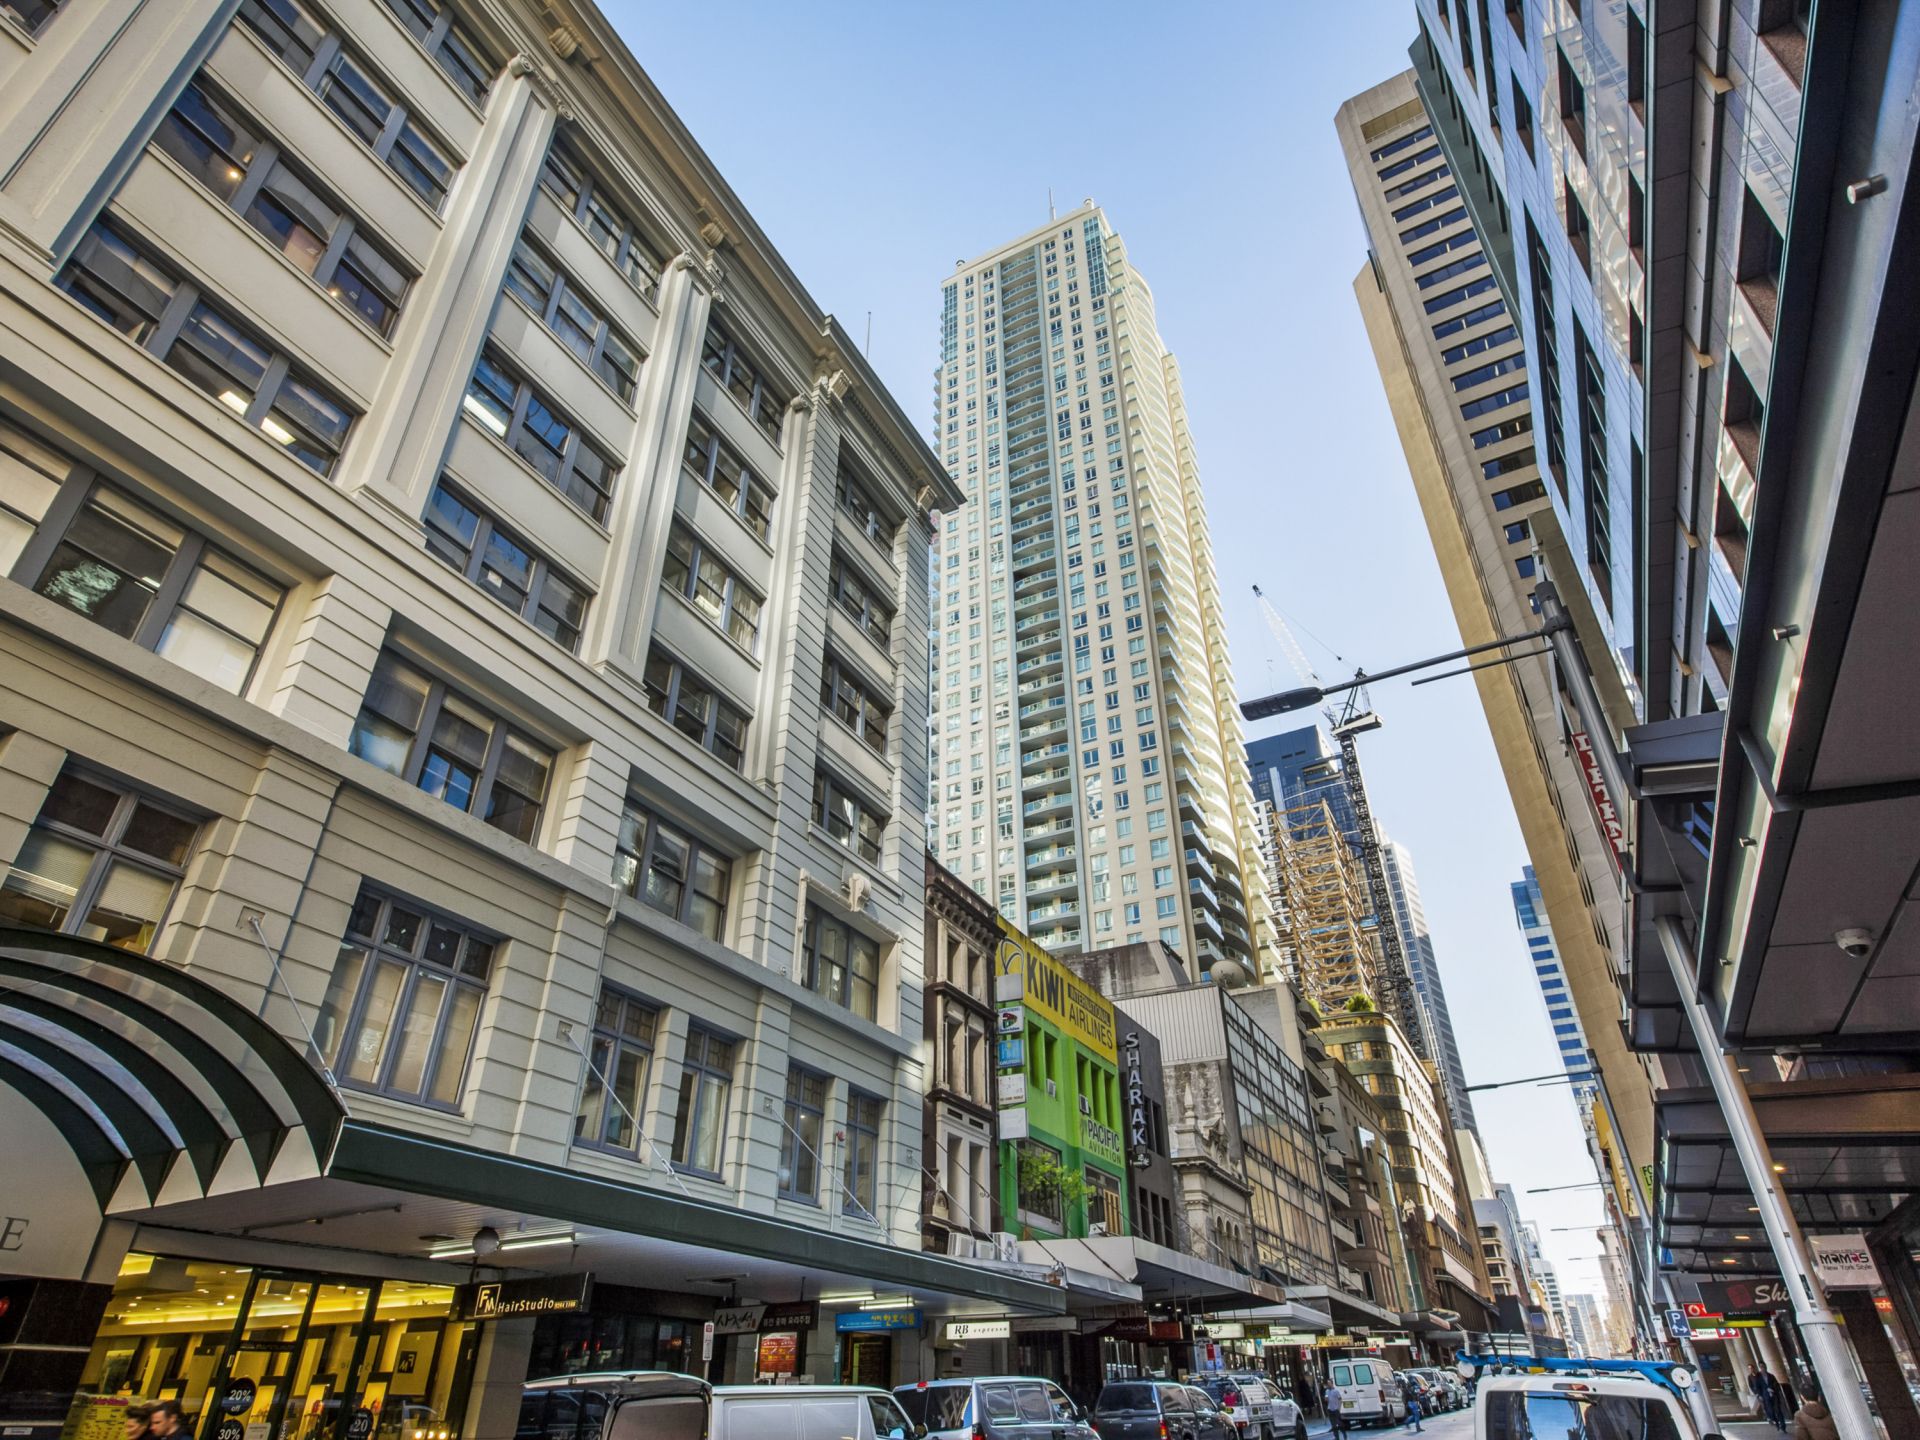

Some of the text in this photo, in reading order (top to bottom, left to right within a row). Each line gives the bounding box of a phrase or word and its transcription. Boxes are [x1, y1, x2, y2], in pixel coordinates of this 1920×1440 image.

[1027, 952, 1065, 1017] KIWI
[1069, 1003, 1113, 1049] AIRLINES
[1126, 1032, 1146, 1145] SHARAK
[1088, 1120, 1120, 1152] PACIFIC
[1088, 1140, 1121, 1165] AVIATION
[1671, 1313, 1681, 1323] P
[954, 1324, 969, 1335] RB
[228, 1389, 251, 1402] 20%
[231, 1404, 241, 1412] off
[218, 1428, 240, 1440] 30%
